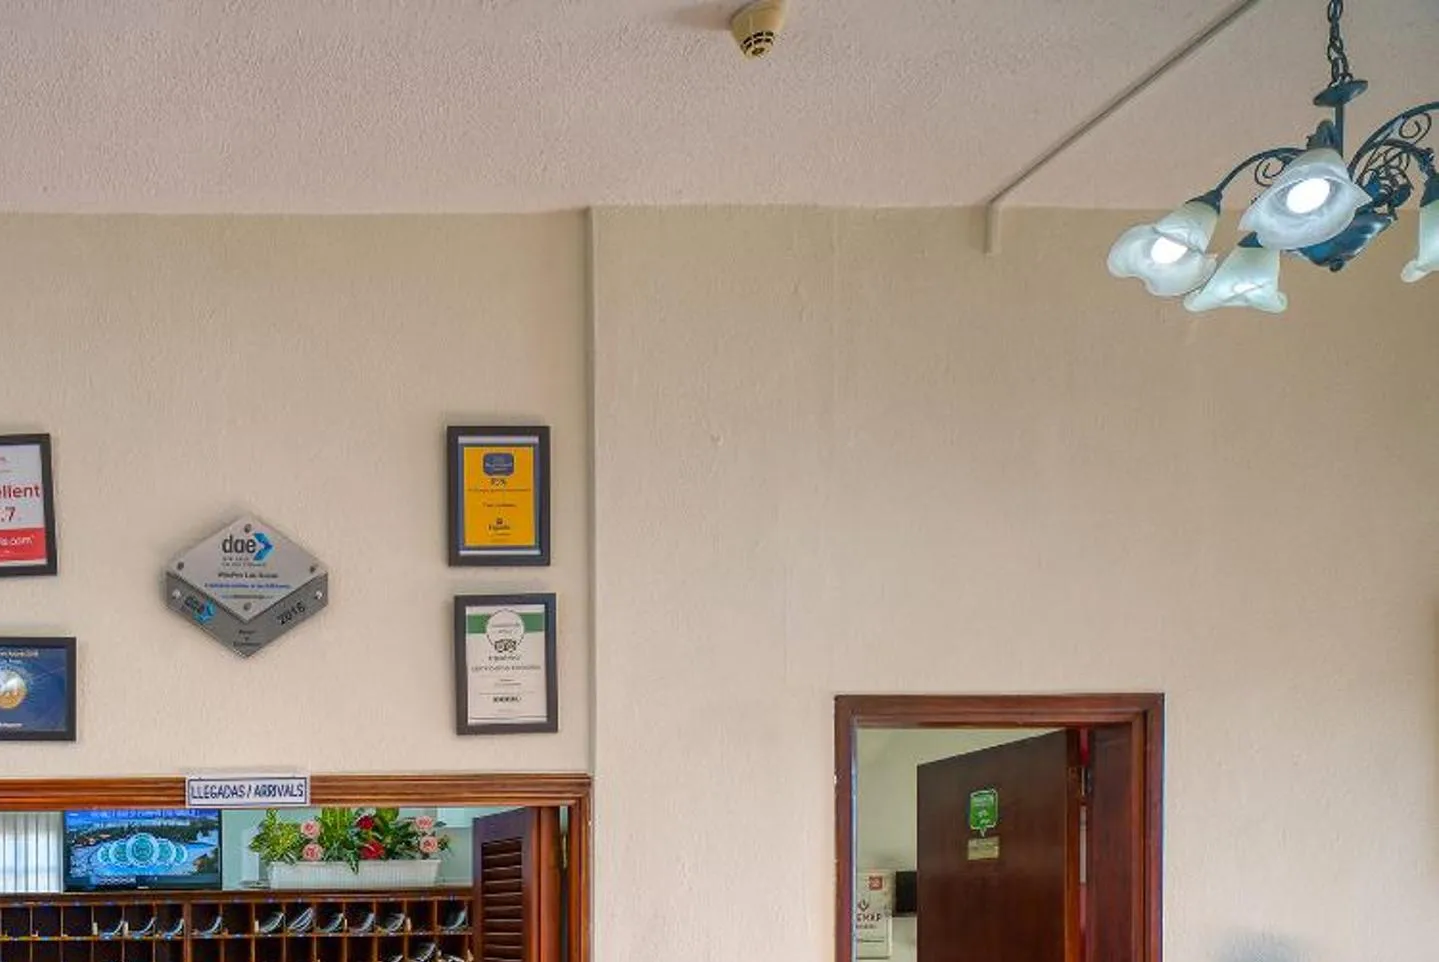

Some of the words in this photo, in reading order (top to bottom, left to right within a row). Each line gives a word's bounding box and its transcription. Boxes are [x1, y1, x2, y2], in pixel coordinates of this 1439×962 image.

[222, 535, 257, 554] dae
[190, 784, 246, 799] LLEGADAS
[254, 783, 304, 798] ARRIVALS
